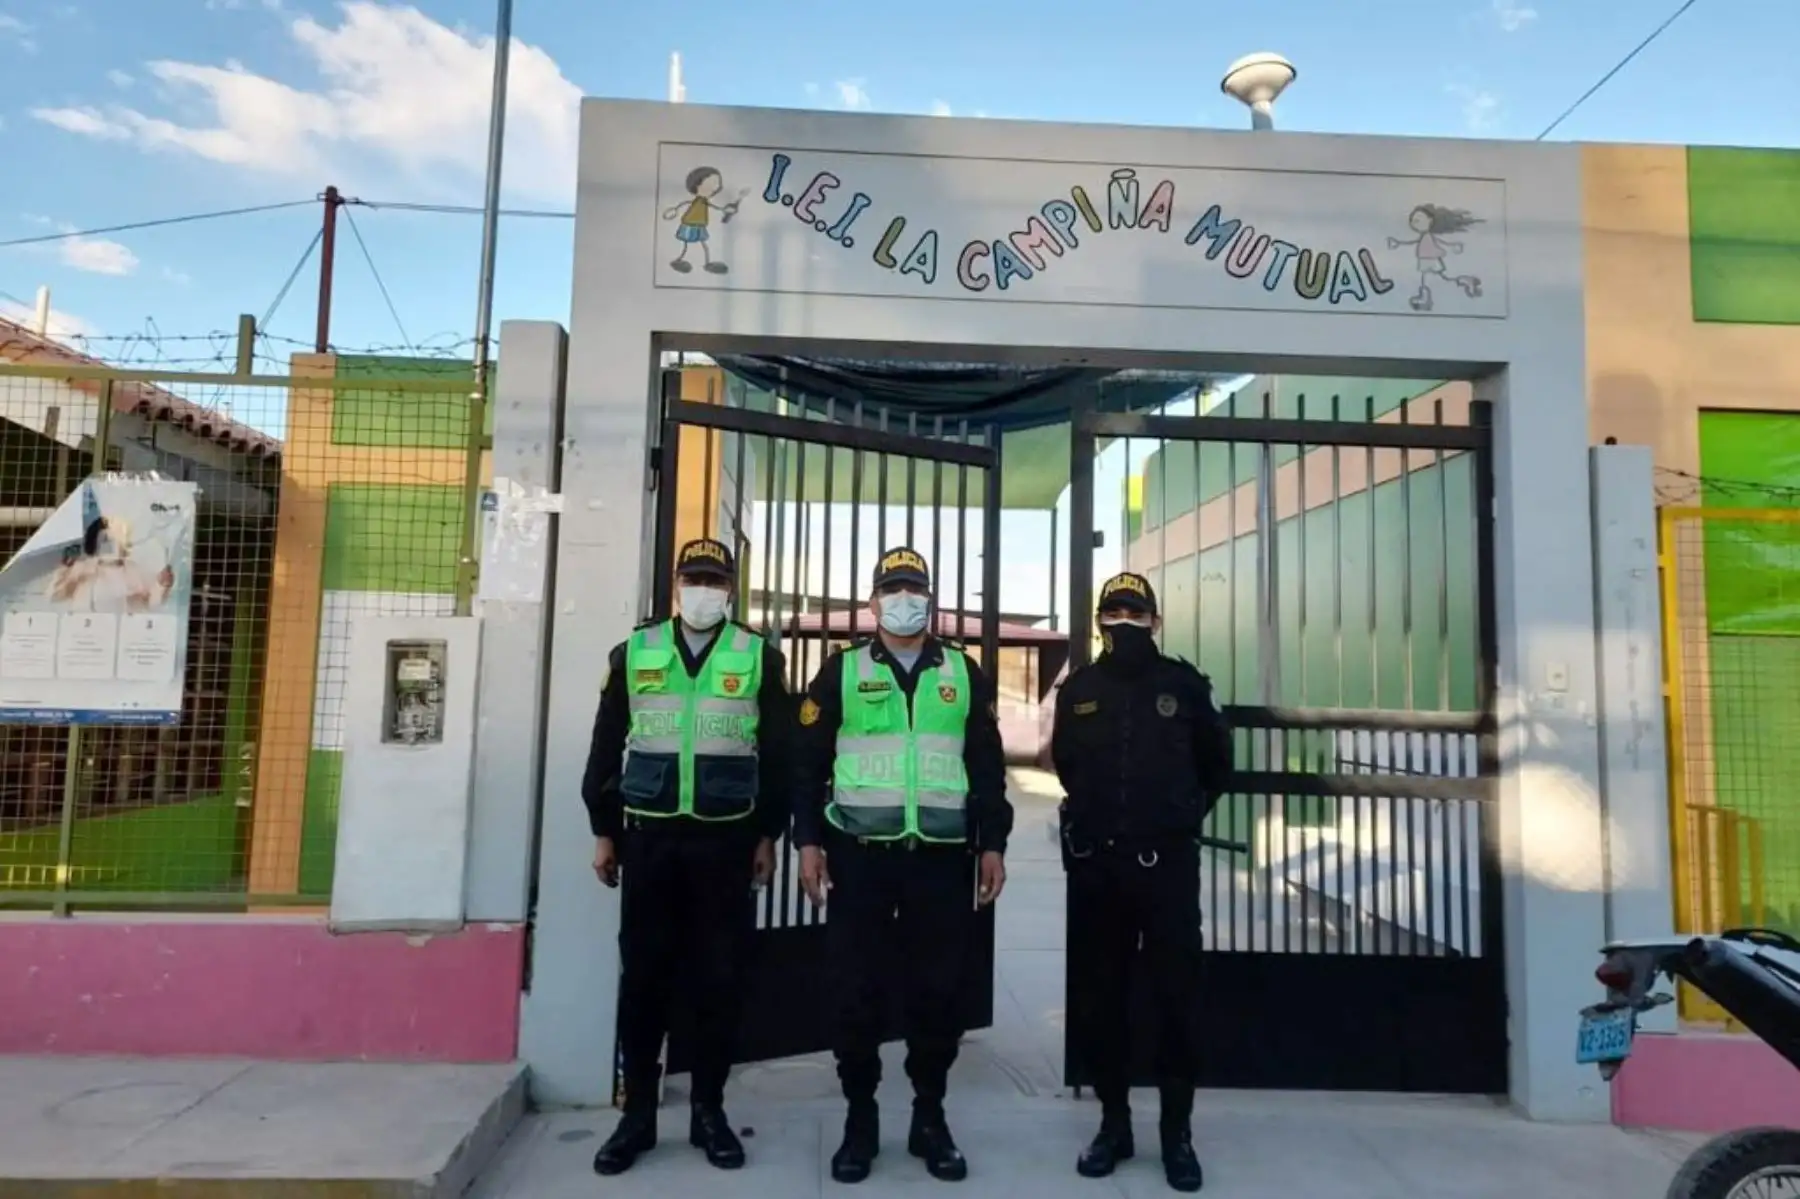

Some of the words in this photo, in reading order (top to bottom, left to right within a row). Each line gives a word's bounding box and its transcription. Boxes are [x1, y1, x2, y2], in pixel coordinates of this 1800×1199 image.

[763, 154, 871, 247] I.E.I.
[873, 216, 938, 284] LA
[957, 168, 1175, 292] CAMPIÑA
[1185, 205, 1394, 304] MUTUAL
[683, 541, 726, 565] POLICIA
[881, 551, 925, 574] POLICIA
[1104, 574, 1147, 598] POLICIA
